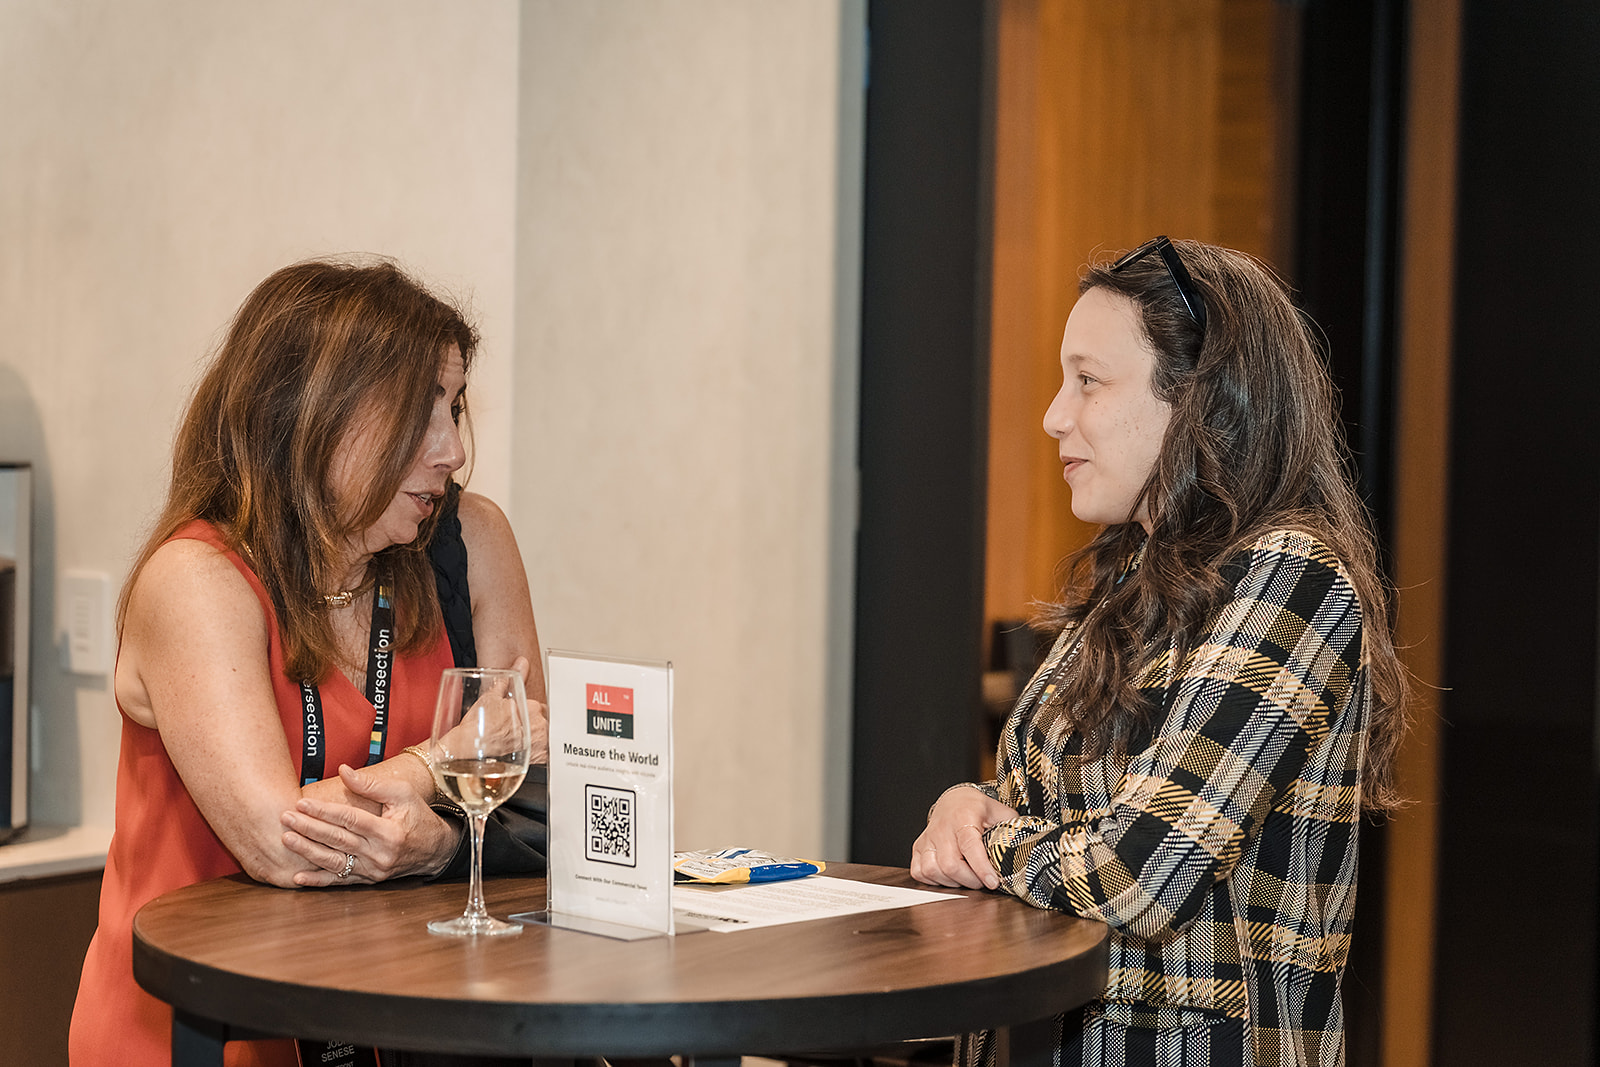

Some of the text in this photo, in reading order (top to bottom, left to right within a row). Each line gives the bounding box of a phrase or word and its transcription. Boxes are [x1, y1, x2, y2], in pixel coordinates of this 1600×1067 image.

[592, 691, 611, 706] ALL
[302, 679, 320, 757] ersection
[592, 716, 622, 732] UNITE
[563, 743, 659, 766] Measure the World
[321, 1045, 355, 1062] SENESE
